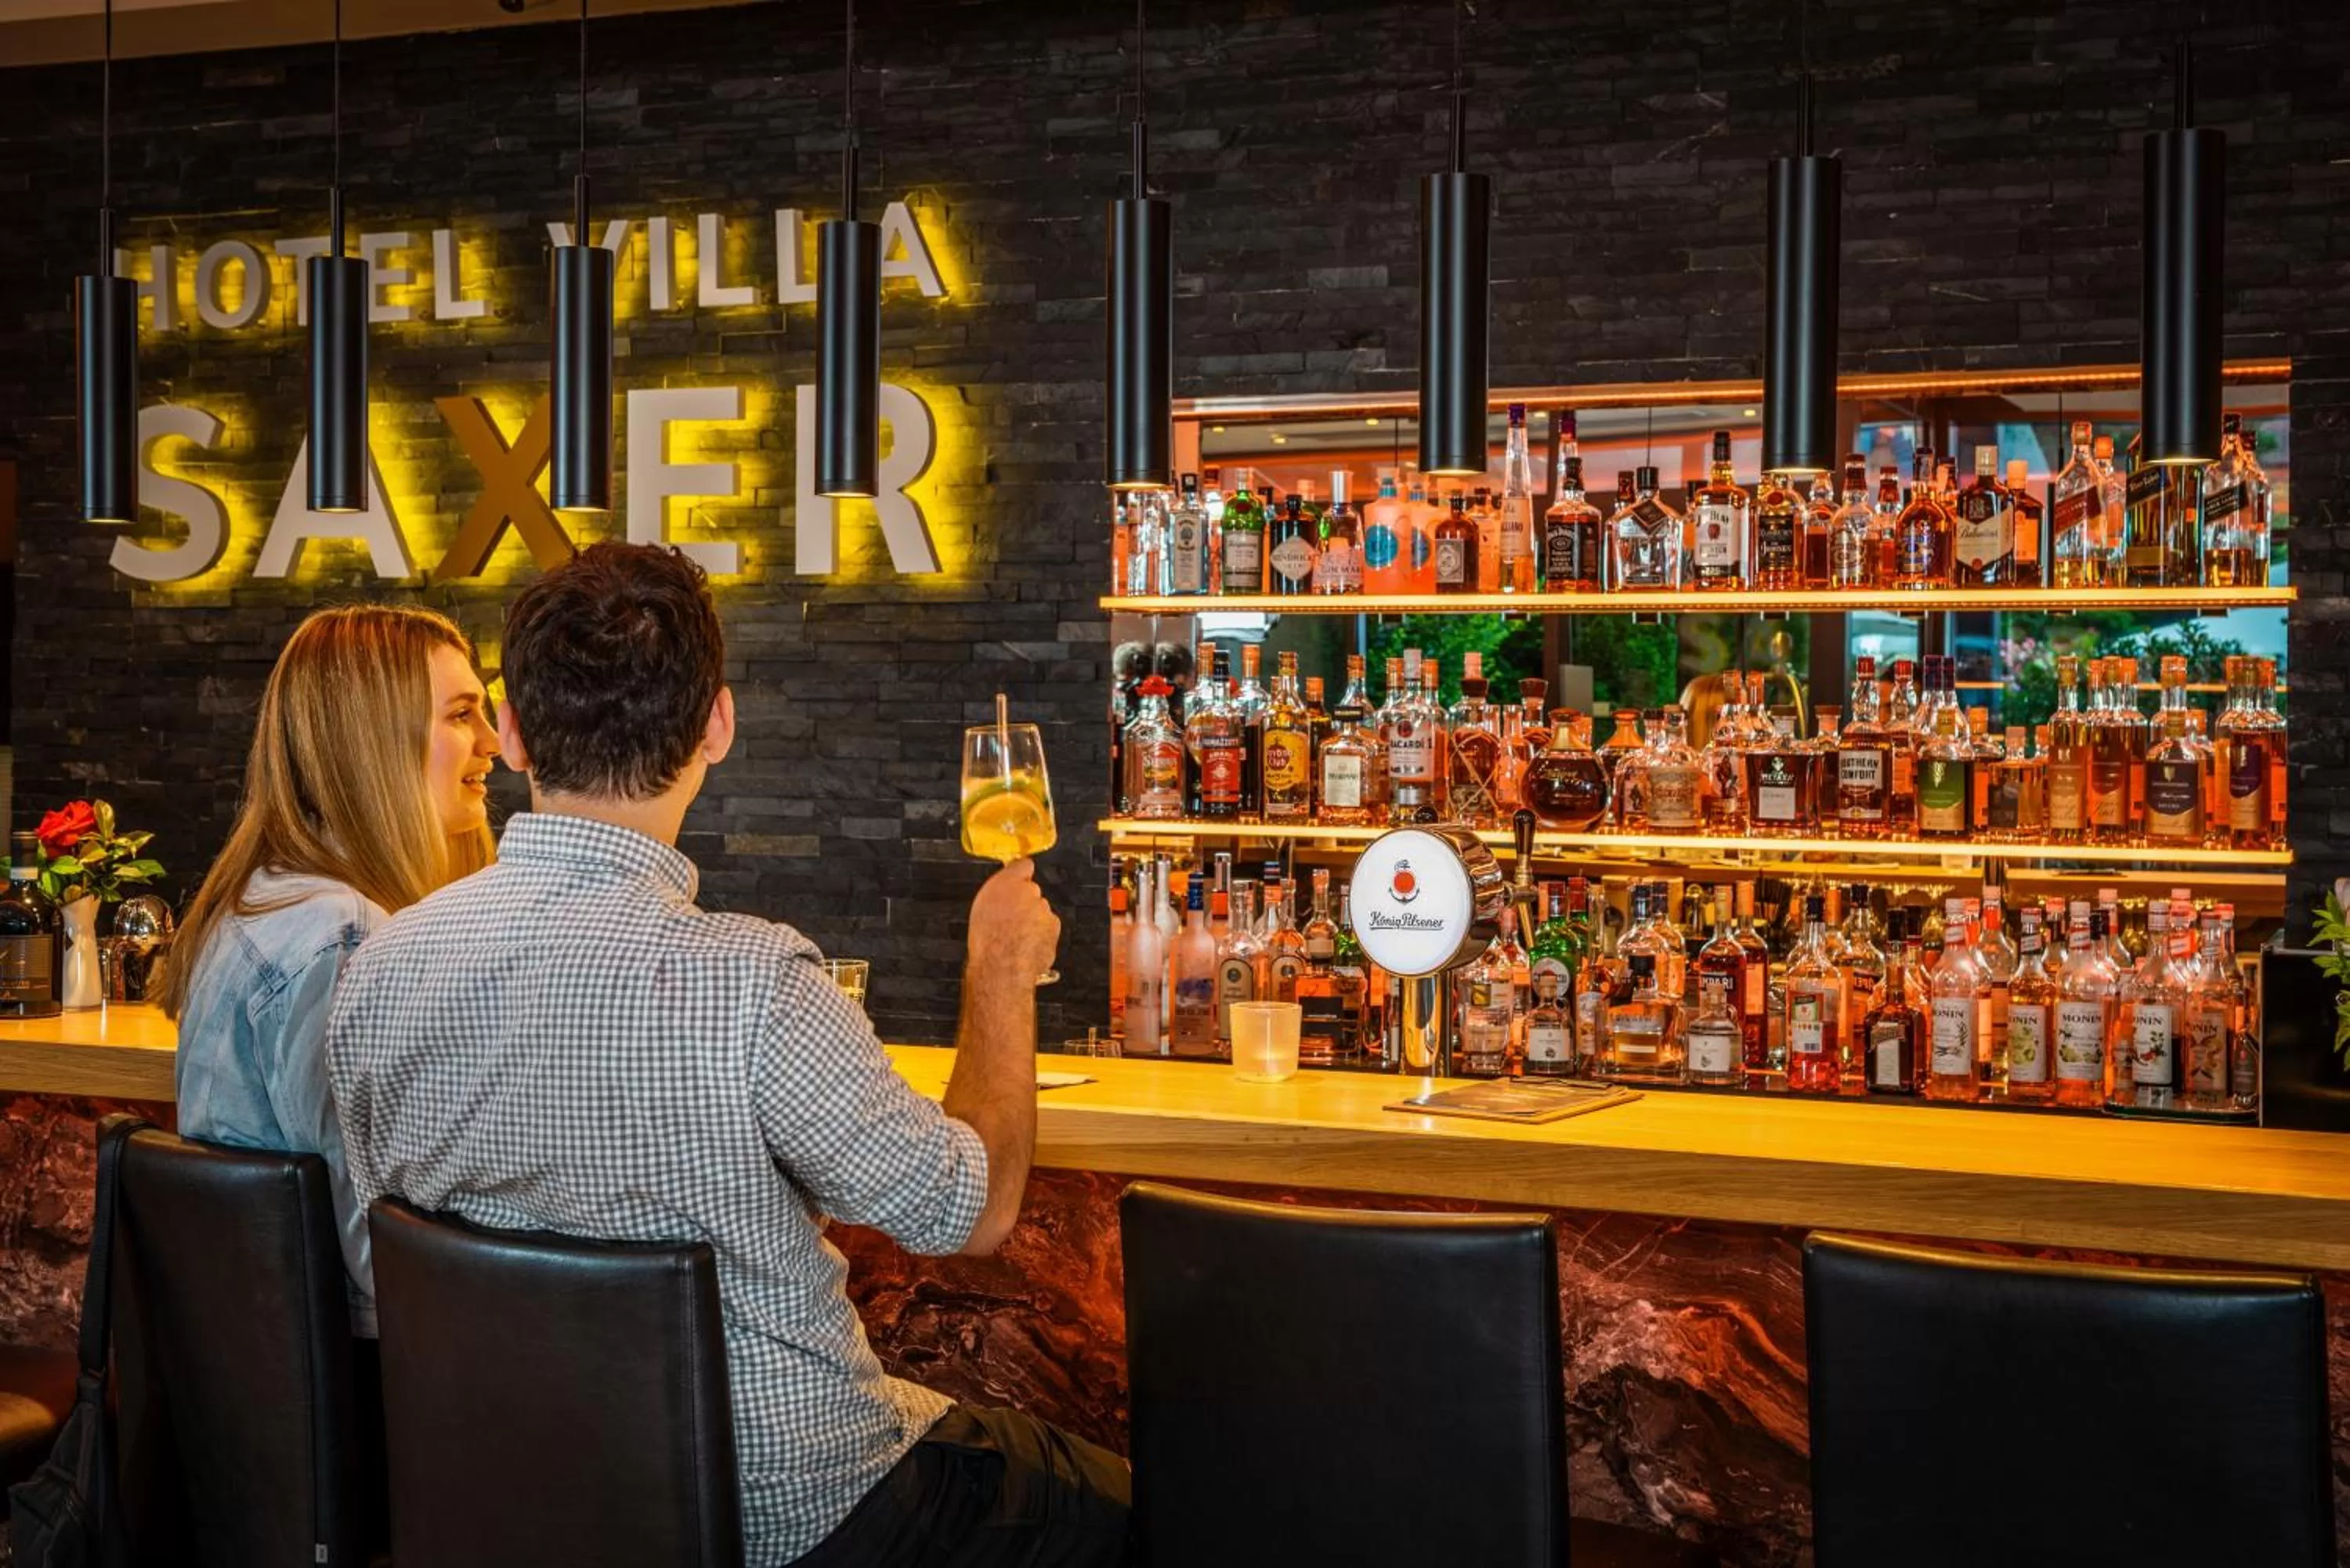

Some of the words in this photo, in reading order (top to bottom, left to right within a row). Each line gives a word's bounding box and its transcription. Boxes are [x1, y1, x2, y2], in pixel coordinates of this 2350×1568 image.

[114, 229, 487, 331] HOTEL
[110, 383, 940, 582] SAXER
[1841, 757, 1879, 768] OUTHERN
[1368, 911, 1401, 930] König
[1401, 912, 1444, 927] Pilsener
[1700, 977, 1734, 989] MPARI
[1933, 1007, 1964, 1019] ONIN
[2062, 1013, 2102, 1024] MONIN
